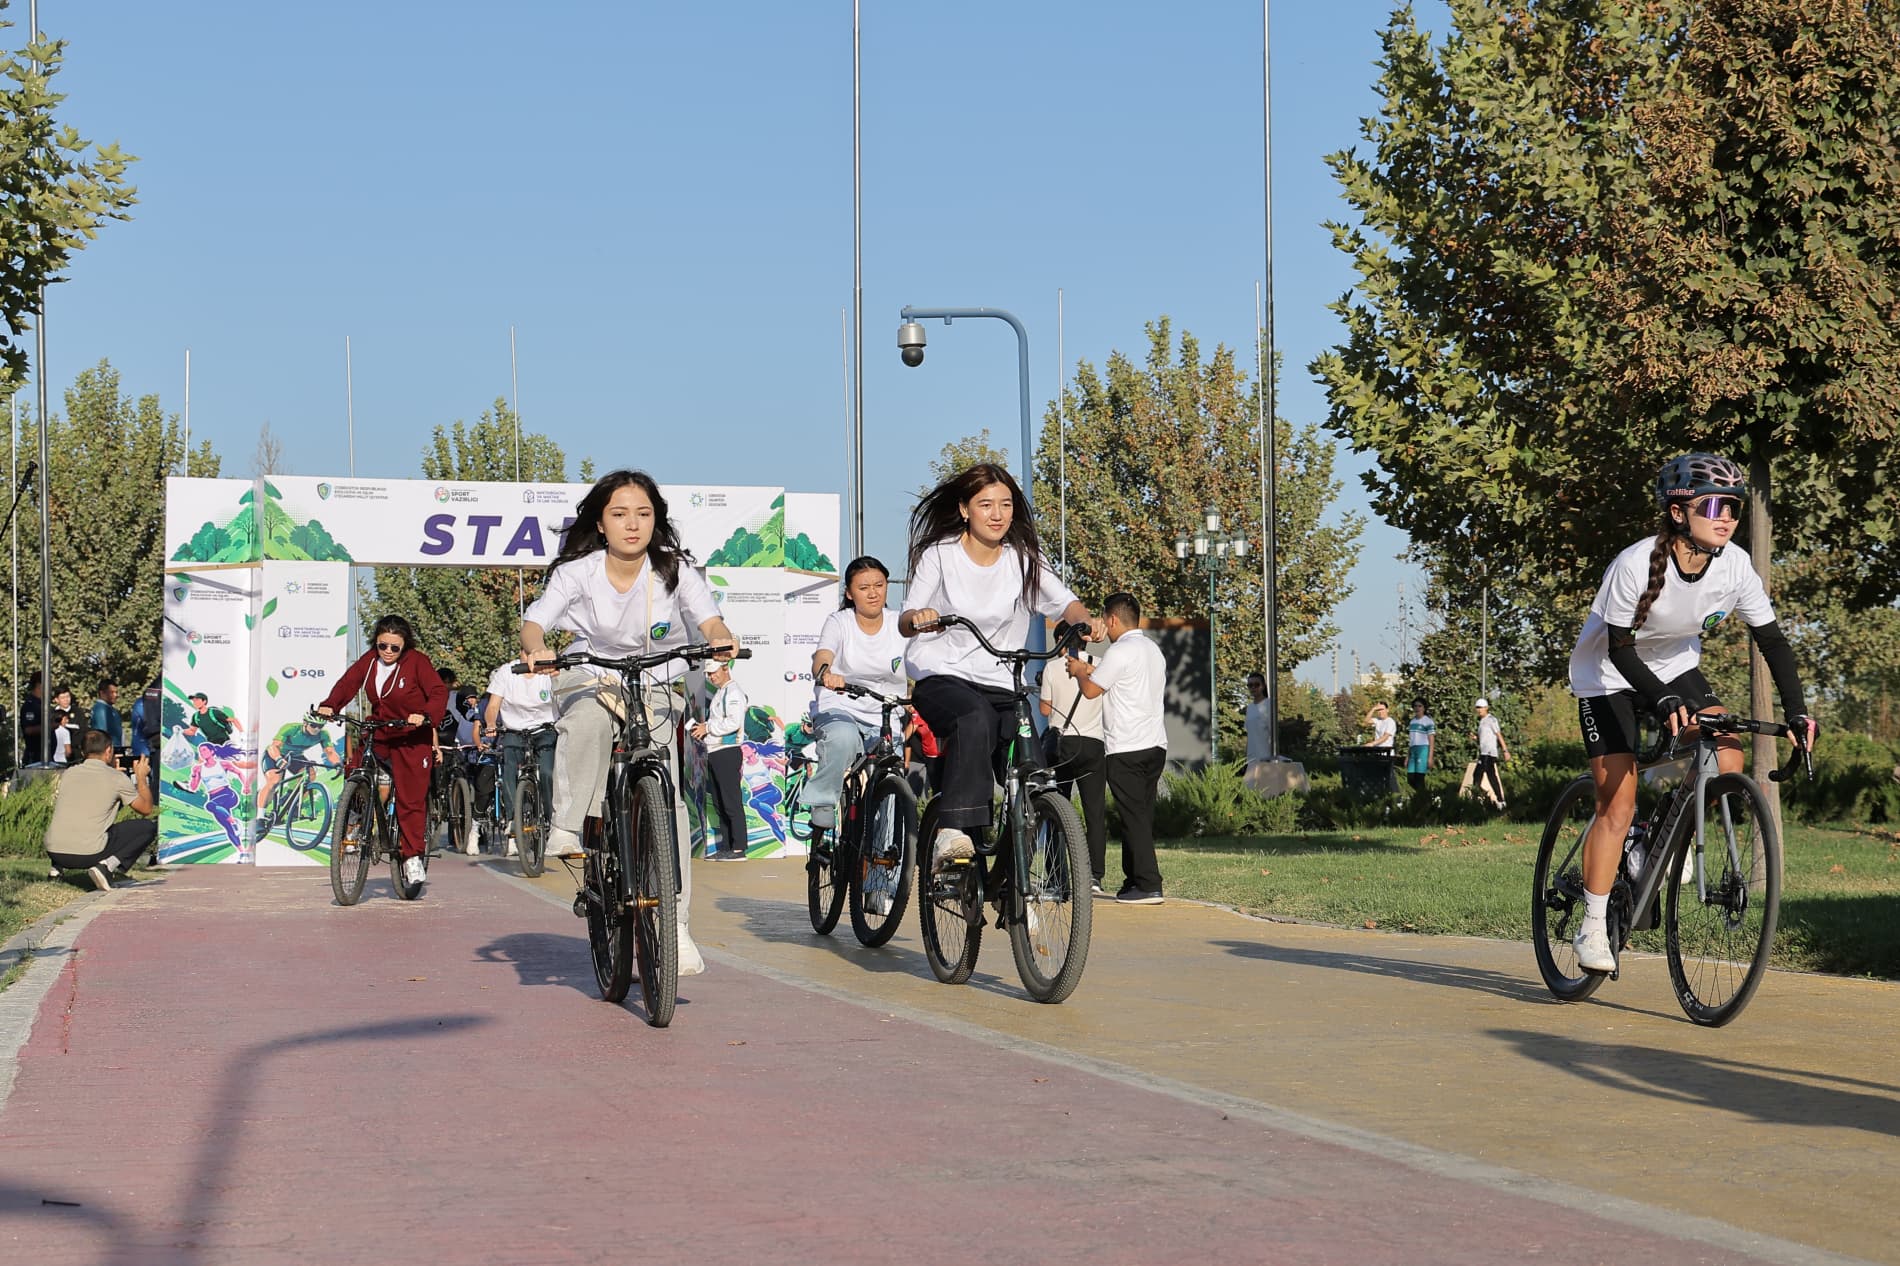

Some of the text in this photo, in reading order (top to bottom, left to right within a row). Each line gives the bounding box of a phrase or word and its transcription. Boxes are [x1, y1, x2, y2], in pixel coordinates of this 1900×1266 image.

[1666, 488, 1696, 496] catlike
[419, 513, 577, 556] STA
[300, 669, 325, 678] SQB
[1581, 698, 1600, 742] MILOTO
